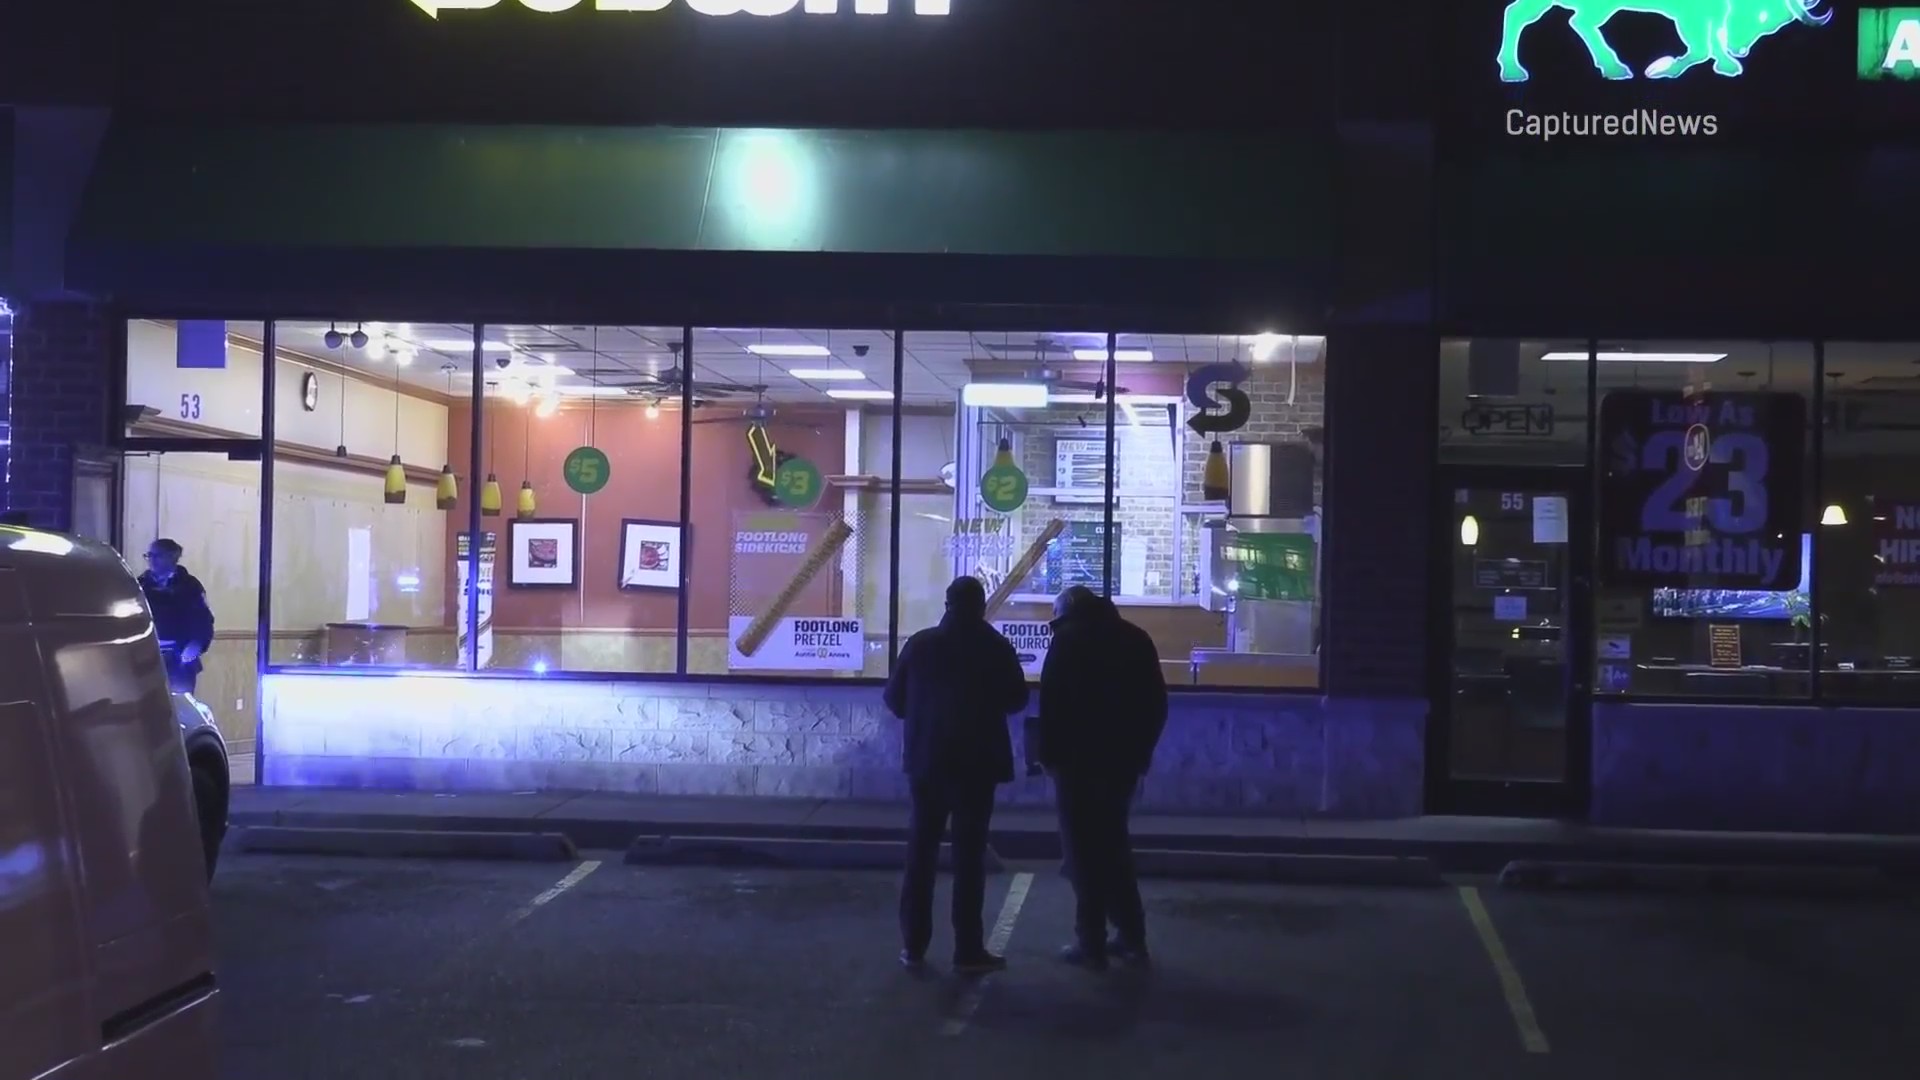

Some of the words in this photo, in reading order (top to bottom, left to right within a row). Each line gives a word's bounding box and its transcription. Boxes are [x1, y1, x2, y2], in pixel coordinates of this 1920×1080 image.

[181, 393, 200, 419] 53
[1652, 400, 1710, 424] Low
[1719, 400, 1755, 425] As
[1463, 406, 1553, 434] OPEN
[569, 457, 599, 484] $5
[780, 470, 810, 495] $3
[986, 476, 1017, 501] $2
[1501, 492, 1524, 510] 55
[953, 518, 1006, 534] NEW
[1896, 505, 1920, 530] N
[735, 531, 809, 543] FOOTLONG
[734, 542, 807, 554] SIDEKICKS
[1615, 535, 1785, 585] Monthly
[794, 620, 859, 633] FOOTLONG
[1002, 623, 1052, 636] FOOTLO
[794, 633, 842, 646] PRETZEL
[1009, 637, 1050, 650] HURRO
